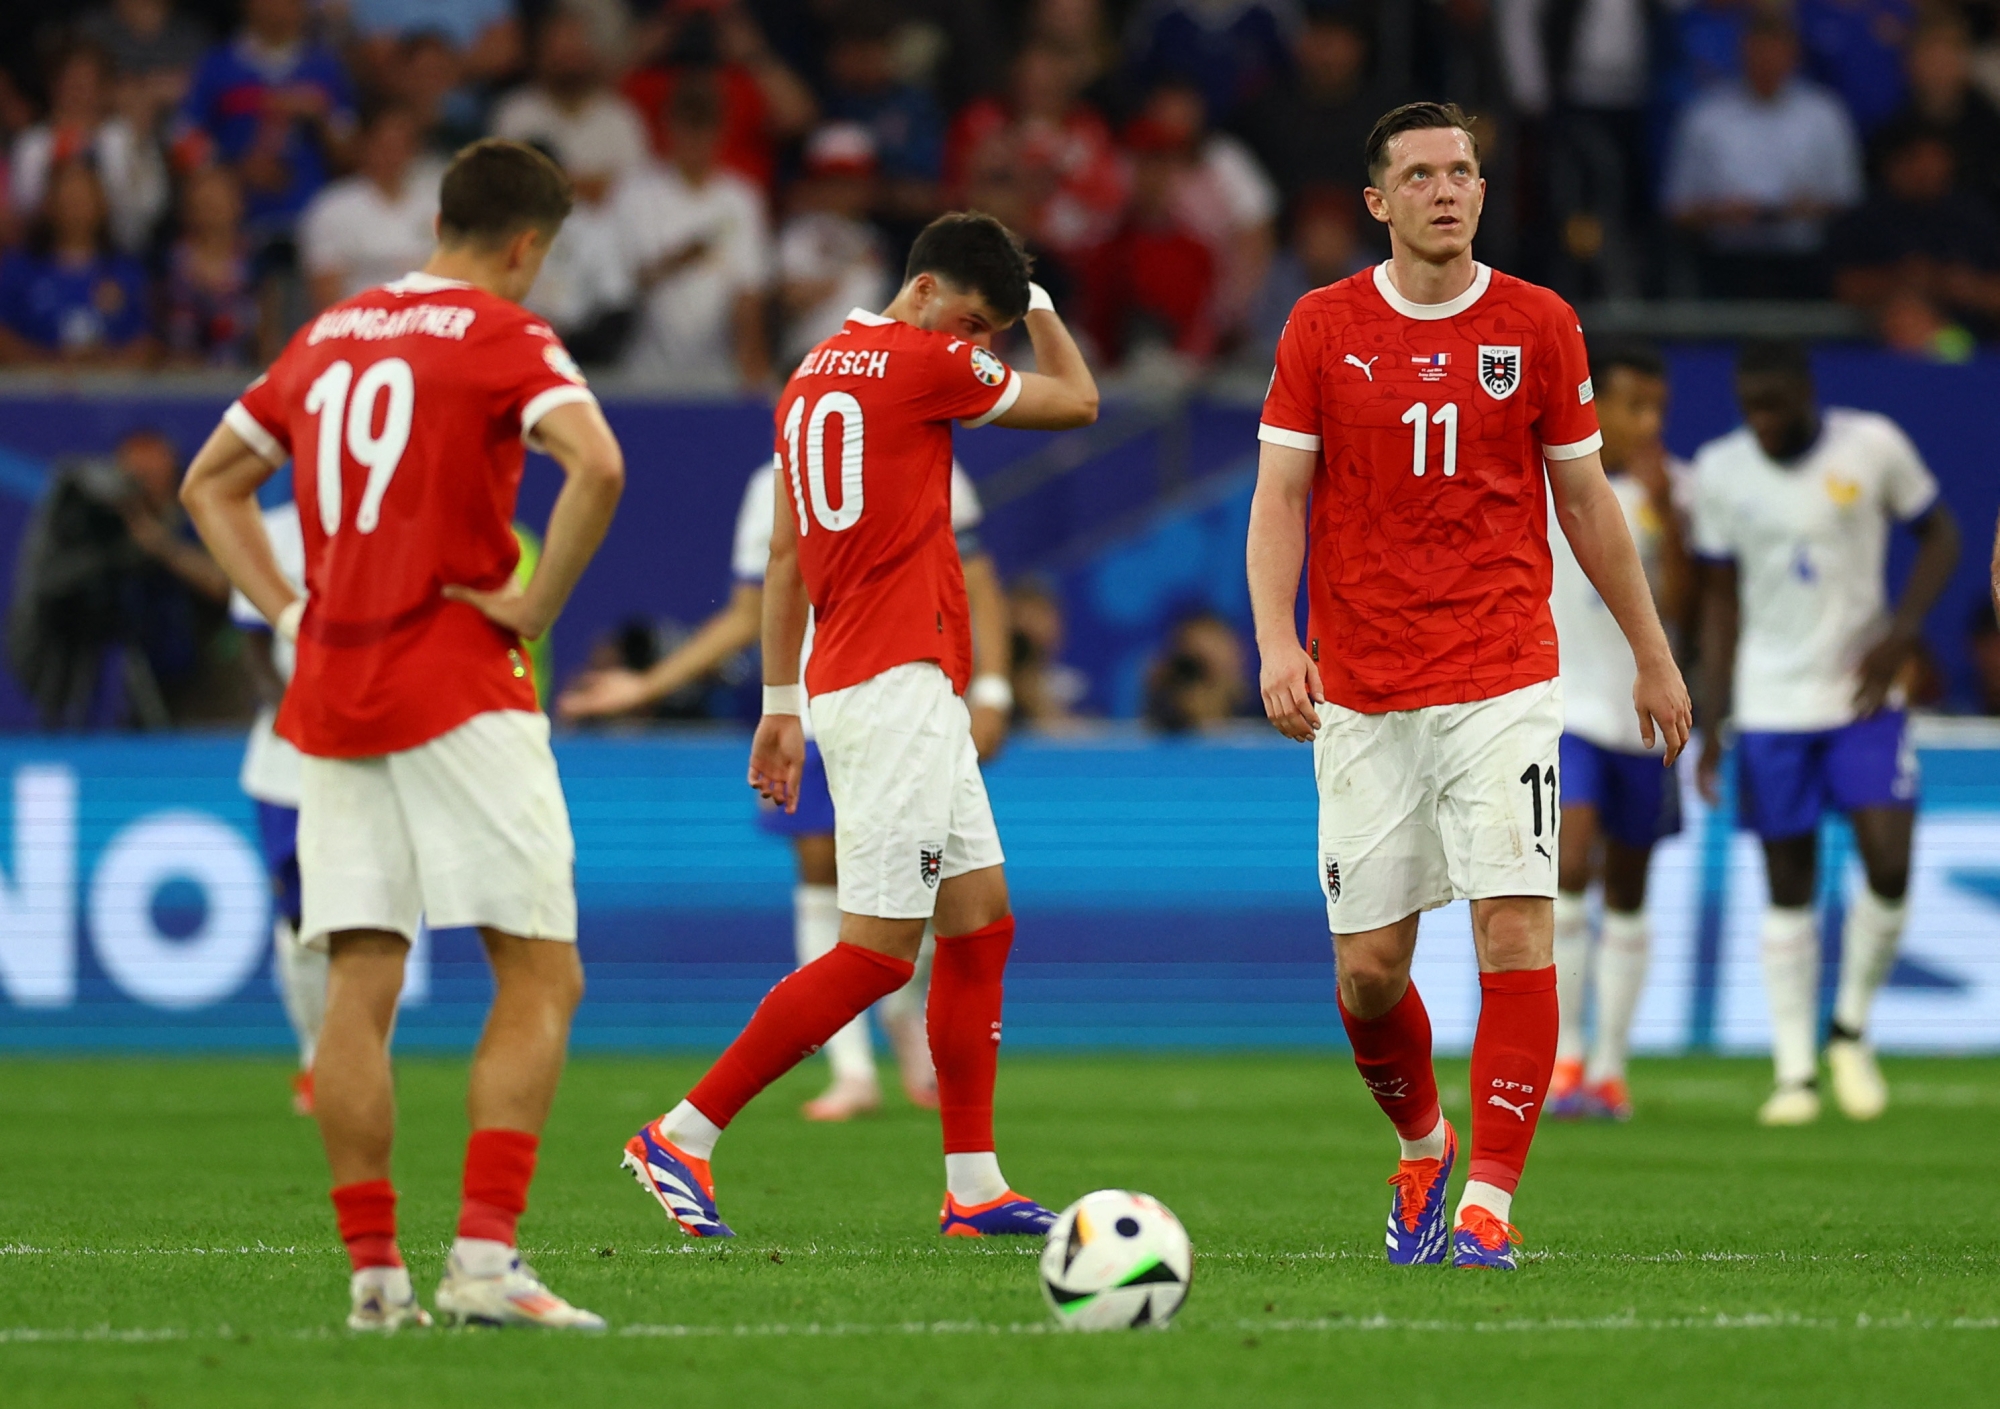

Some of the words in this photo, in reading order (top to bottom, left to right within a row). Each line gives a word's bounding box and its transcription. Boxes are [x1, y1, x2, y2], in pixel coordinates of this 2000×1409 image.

[304, 357, 414, 536] 19
[783, 390, 864, 537] 10
[1401, 402, 1458, 476] 11
[1520, 763, 1556, 837] 11
[1491, 1078, 1534, 1094] ÖFB
